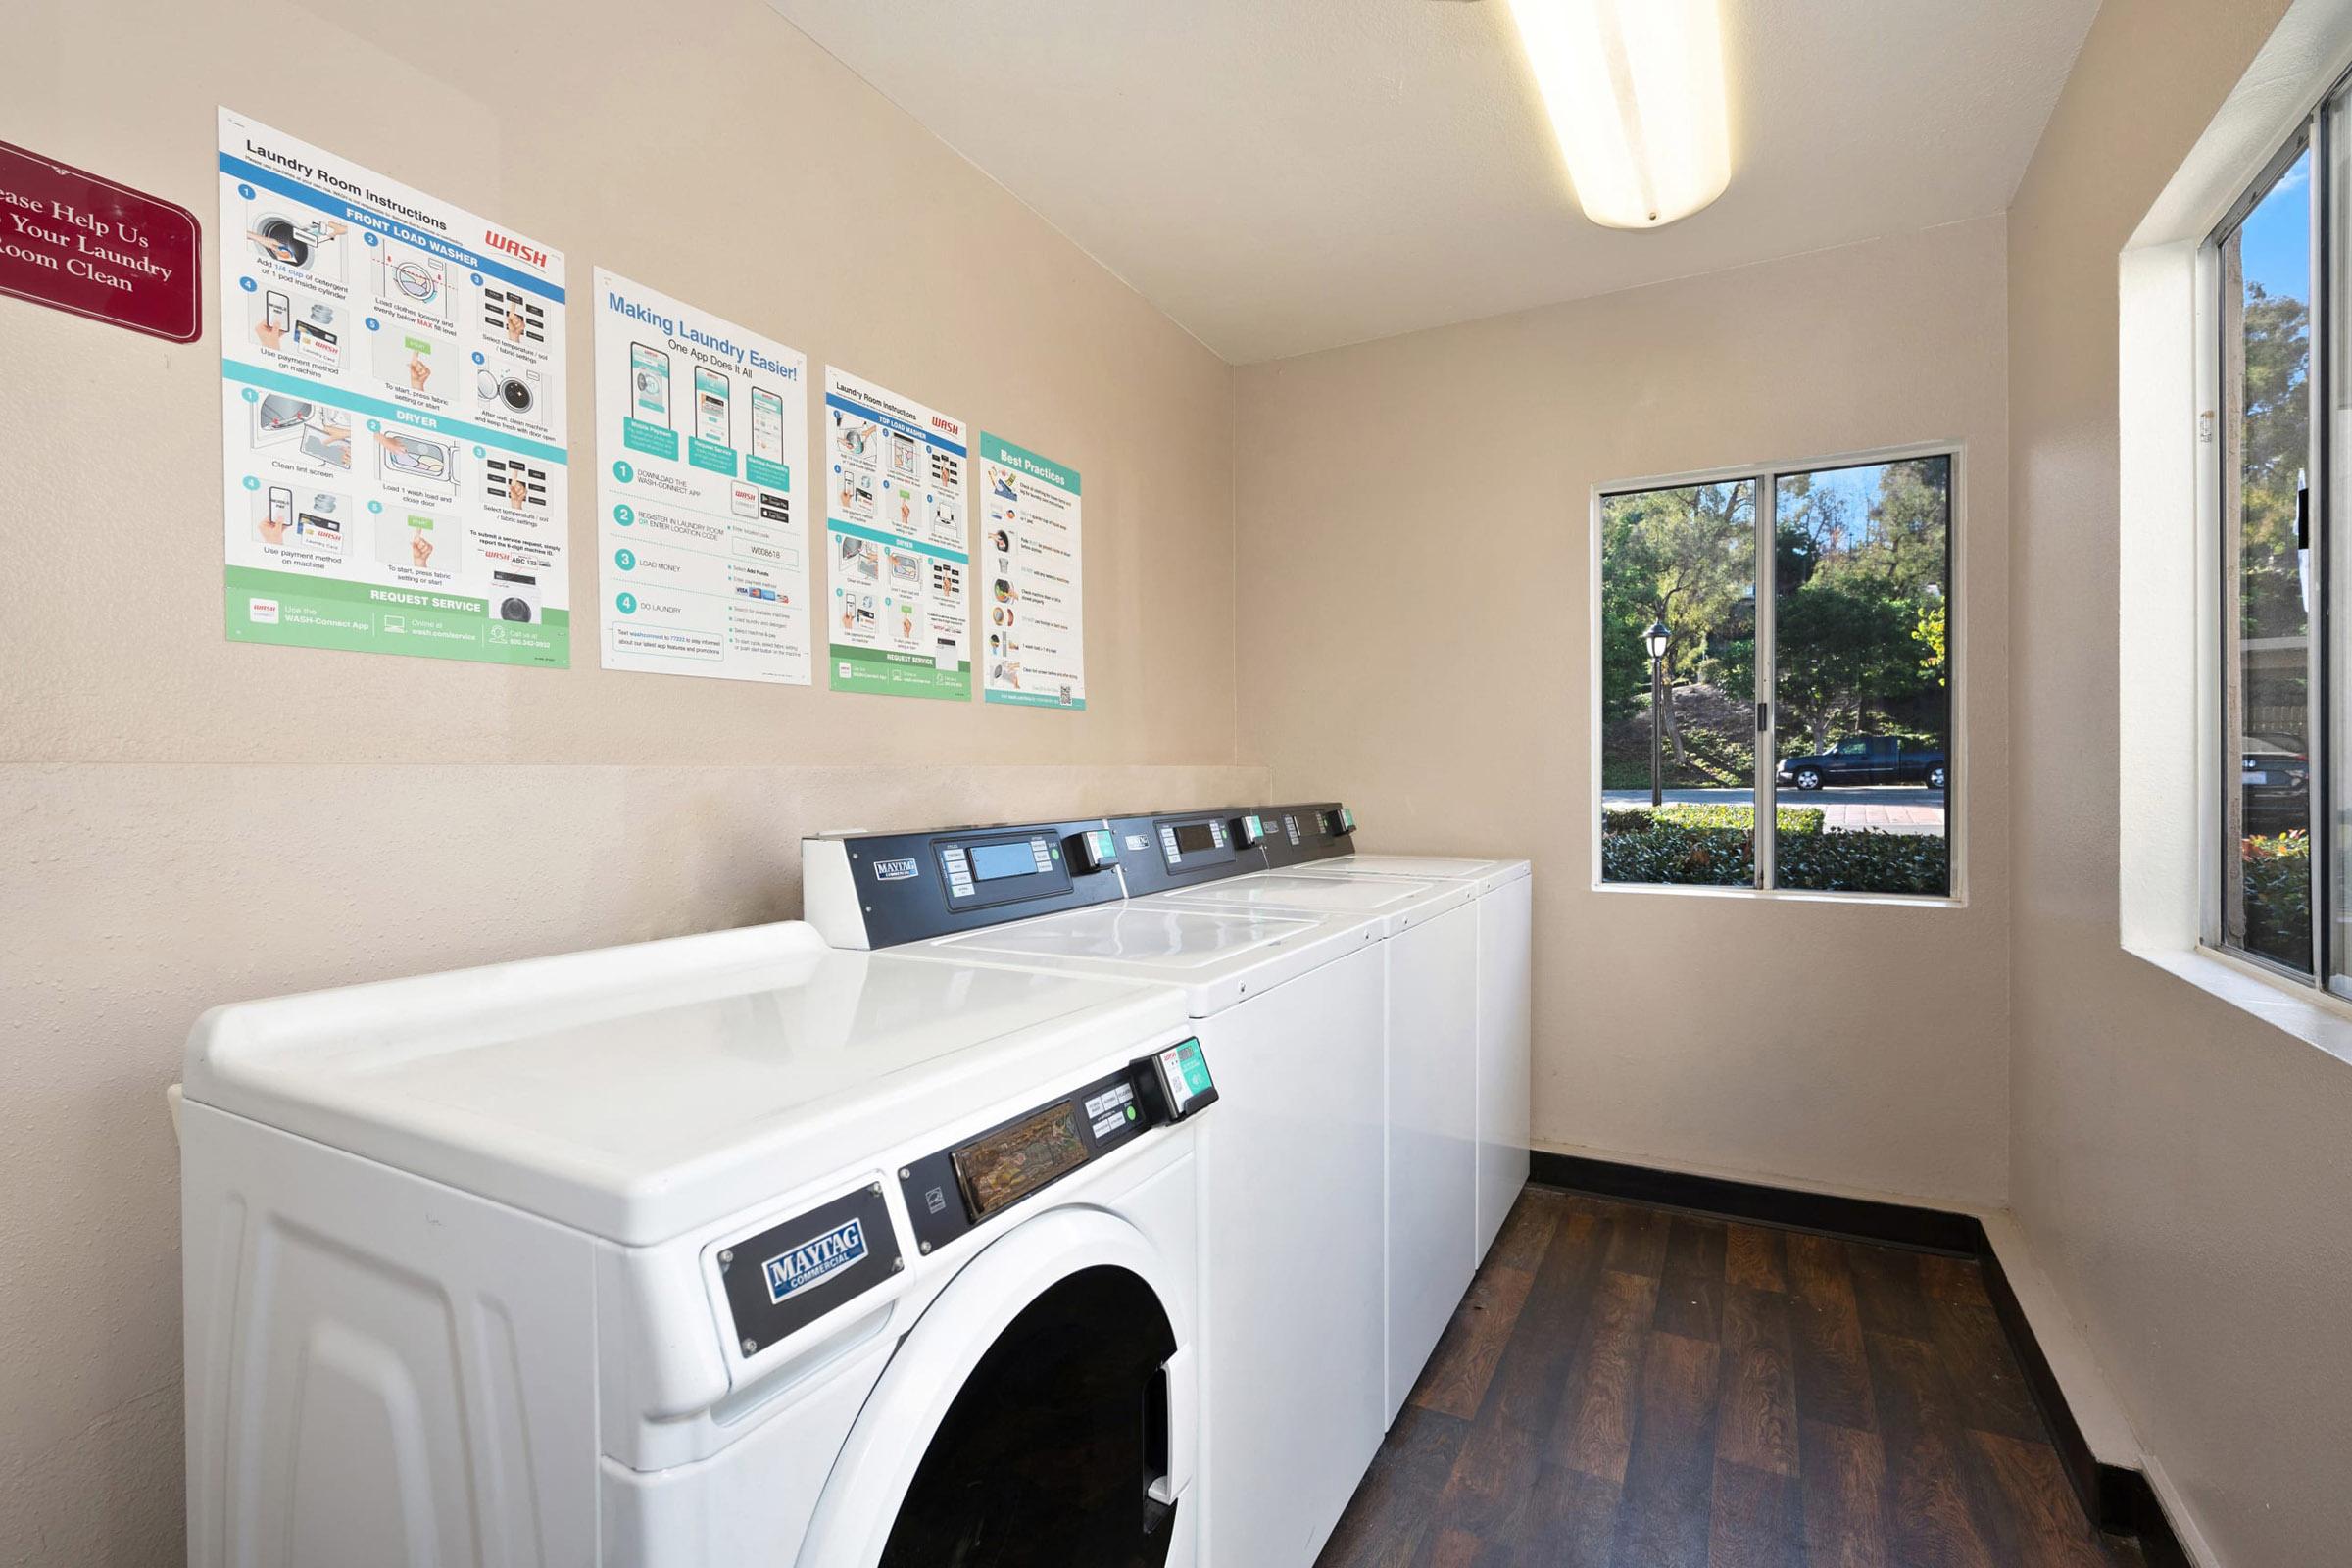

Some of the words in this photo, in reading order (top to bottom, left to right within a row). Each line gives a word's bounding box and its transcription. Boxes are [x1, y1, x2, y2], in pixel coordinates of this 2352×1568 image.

[247, 139, 312, 177] Laundry
[318, 170, 361, 196] Room
[367, 188, 447, 231] Instructions
[51, 201, 109, 236] Help
[117, 222, 148, 248] Us
[346, 208, 389, 232] FRONT
[393, 226, 426, 246] LOAD
[429, 241, 479, 268] WASHER
[10, 214, 71, 247] Your
[77, 234, 172, 282] Laundry
[485, 230, 547, 268] WASH
[67, 259, 133, 292] Clean
[257, 258, 272, 268] Add
[274, 263, 286, 272] 1/4
[289, 269, 304, 278] cup
[315, 277, 349, 293] detergent
[278, 274, 293, 283] pod
[295, 279, 318, 291] inside
[318, 286, 346, 301] cylinder
[375, 298, 392, 309] Load
[394, 303, 416, 317] clothes
[442, 318, 454, 328] and
[396, 311, 416, 323] below
[417, 318, 433, 329] MAX
[442, 326, 457, 337] level
[609, 292, 674, 336] Making
[679, 320, 745, 363] Laundry
[750, 349, 798, 381] Easier!
[316, 341, 338, 353] WASH
[261, 348, 276, 358] Use
[278, 352, 311, 368] payment
[312, 361, 338, 374] method
[668, 339, 688, 355] One
[690, 350, 708, 363] App
[710, 356, 733, 371] Does
[735, 366, 740, 374] It
[743, 368, 752, 379] All
[290, 365, 321, 378] machine
[395, 394, 416, 407] setting
[426, 401, 440, 411] start
[413, 389, 429, 401] press
[431, 396, 449, 406] fabric
[836, 381, 862, 400] Laundry
[864, 393, 882, 407] Room
[883, 400, 916, 420] Instructions
[396, 410, 437, 428] DRYER
[878, 416, 890, 426] TOP
[891, 420, 906, 431] LOAD
[906, 425, 926, 440] WASHER
[932, 416, 958, 436] WASH
[272, 461, 294, 470] Clean
[309, 470, 333, 479] screen
[638, 469, 673, 484] DOWNLOAD
[1000, 449, 1022, 467] Best
[1025, 459, 1065, 486] Practices
[383, 484, 399, 493] Load
[424, 491, 439, 501] load
[638, 476, 687, 494] WASH-CONNECT
[403, 496, 419, 505] close
[736, 491, 756, 501] WASH
[638, 511, 668, 522] REGISTER
[677, 520, 705, 530] LAUNDRY
[706, 525, 724, 535] ROOM
[650, 521, 669, 530] ENTER
[671, 526, 701, 537] LOCATION
[702, 532, 718, 541] CODE
[478, 531, 496, 540] submit
[544, 542, 561, 552] simply
[524, 545, 545, 555] machine
[896, 539, 913, 548] DRYER
[264, 546, 279, 555] Use
[281, 550, 314, 561] payment
[315, 555, 342, 564] method
[485, 550, 510, 560] WASH
[294, 561, 324, 569] machine
[416, 569, 432, 580] press
[433, 570, 451, 580] fabric
[659, 563, 681, 572] MONEY
[397, 574, 419, 586] setting
[370, 590, 428, 606] REQUEST
[432, 597, 481, 612] SERVICE
[653, 605, 682, 613] LAUNDRY
[285, 615, 351, 628] WASH-Connect
[352, 621, 368, 630] App
[887, 654, 911, 663] REQUEST
[912, 657, 933, 665] SERVICE
[877, 861, 914, 873] MAYTAG
[769, 1226, 859, 1287] MAYTAG
[790, 1253, 849, 1288] COMMERCIAL
